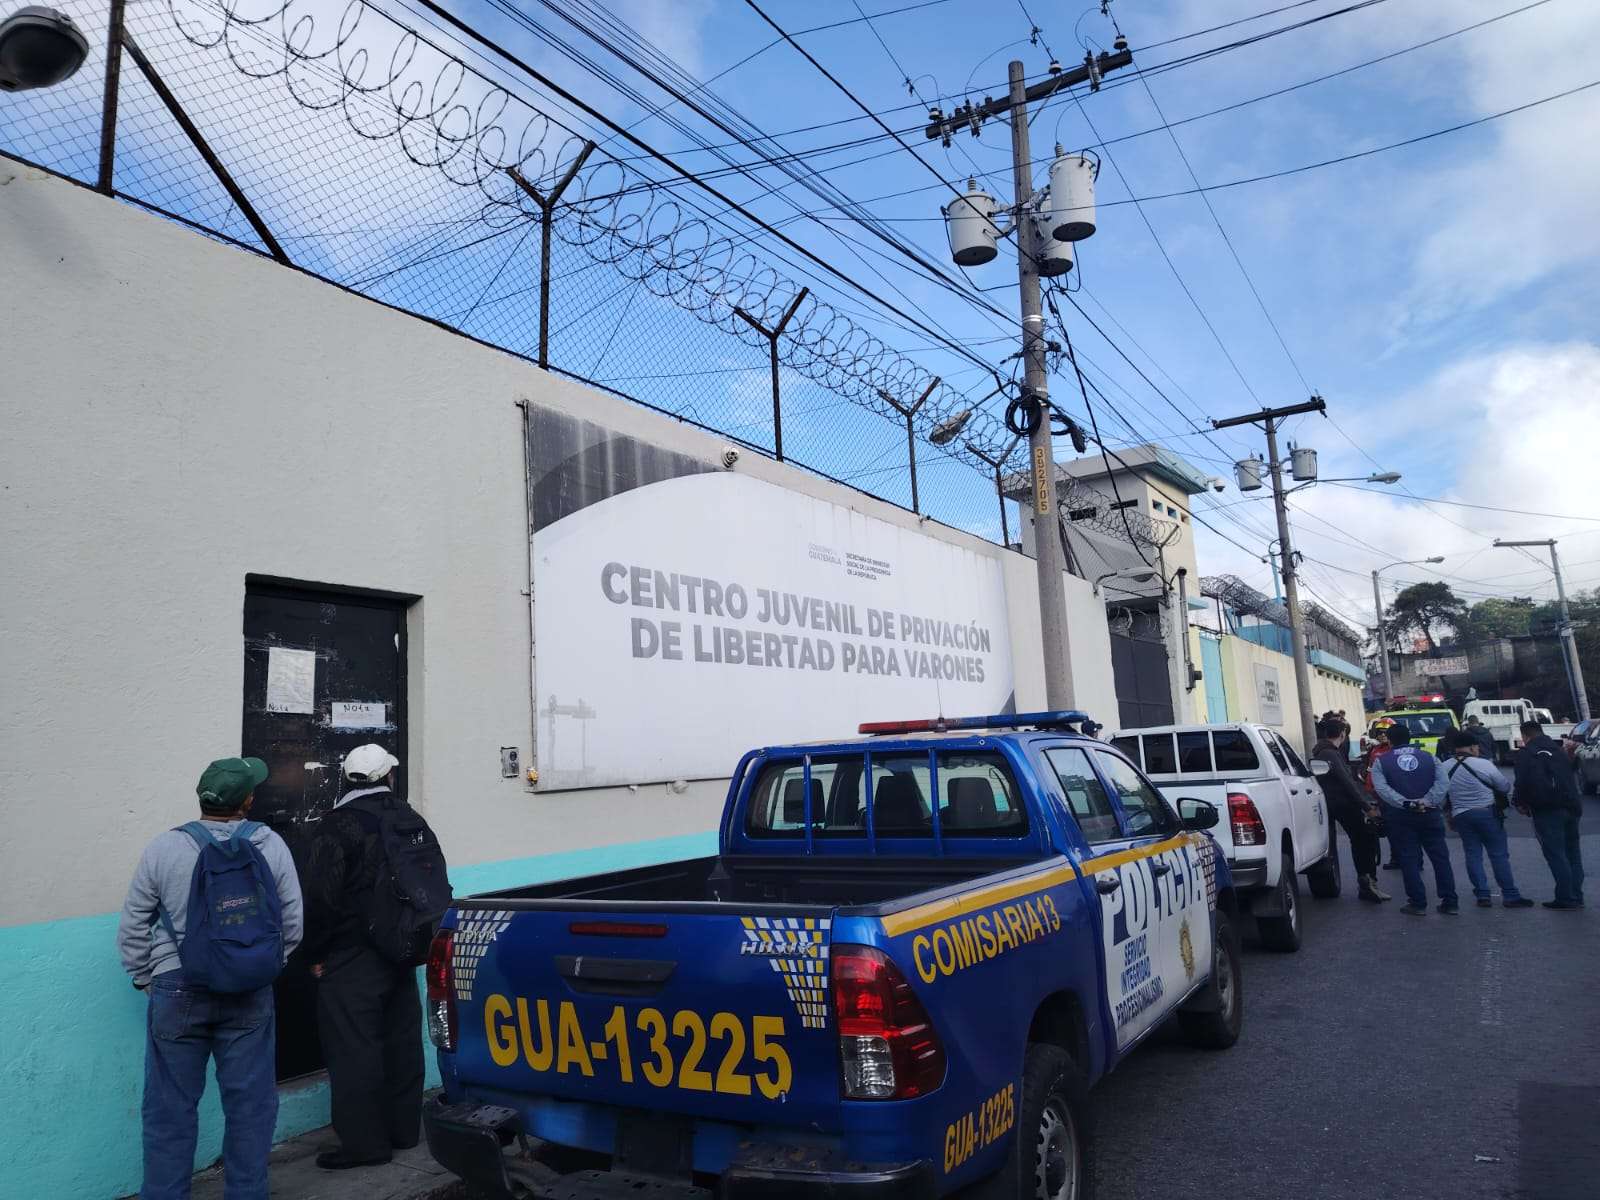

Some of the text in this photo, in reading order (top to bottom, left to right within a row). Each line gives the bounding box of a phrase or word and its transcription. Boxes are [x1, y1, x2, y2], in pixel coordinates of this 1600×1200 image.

[601, 562, 991, 653] CENTRO JUVENIL DE PRIVACIÓN
[631, 618, 985, 683] DE LIBERTAD PARA VARONES
[1094, 840, 1208, 946] POLICIA
[1124, 933, 1147, 967] SERVICIO
[484, 994, 793, 1100] GUA-13225
[944, 1082, 1015, 1175] GUA-13225
